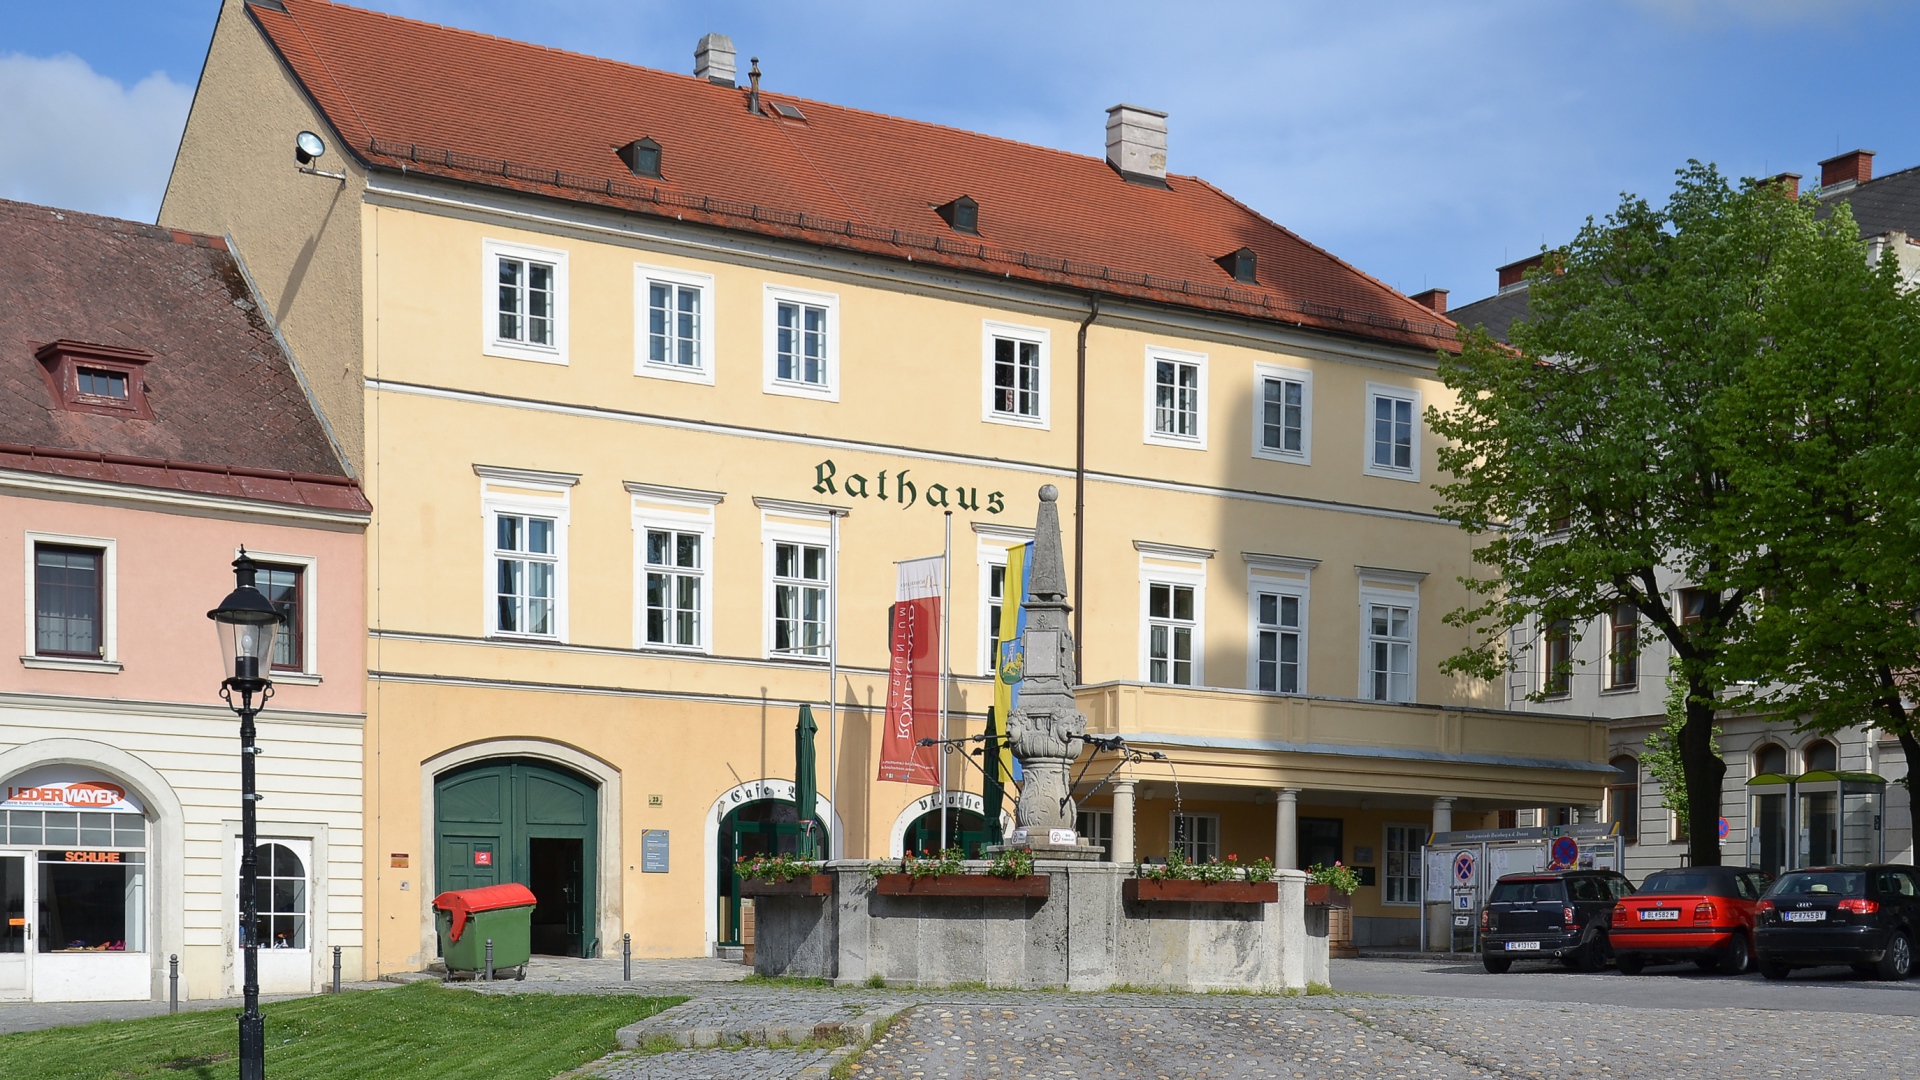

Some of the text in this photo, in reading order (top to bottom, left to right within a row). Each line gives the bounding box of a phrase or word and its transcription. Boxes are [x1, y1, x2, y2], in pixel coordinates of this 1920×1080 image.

[812, 459, 1005, 514] Rathaus
[8, 786, 119, 804] LEDERMAYER
[65, 851, 120, 863] SCHUHE
